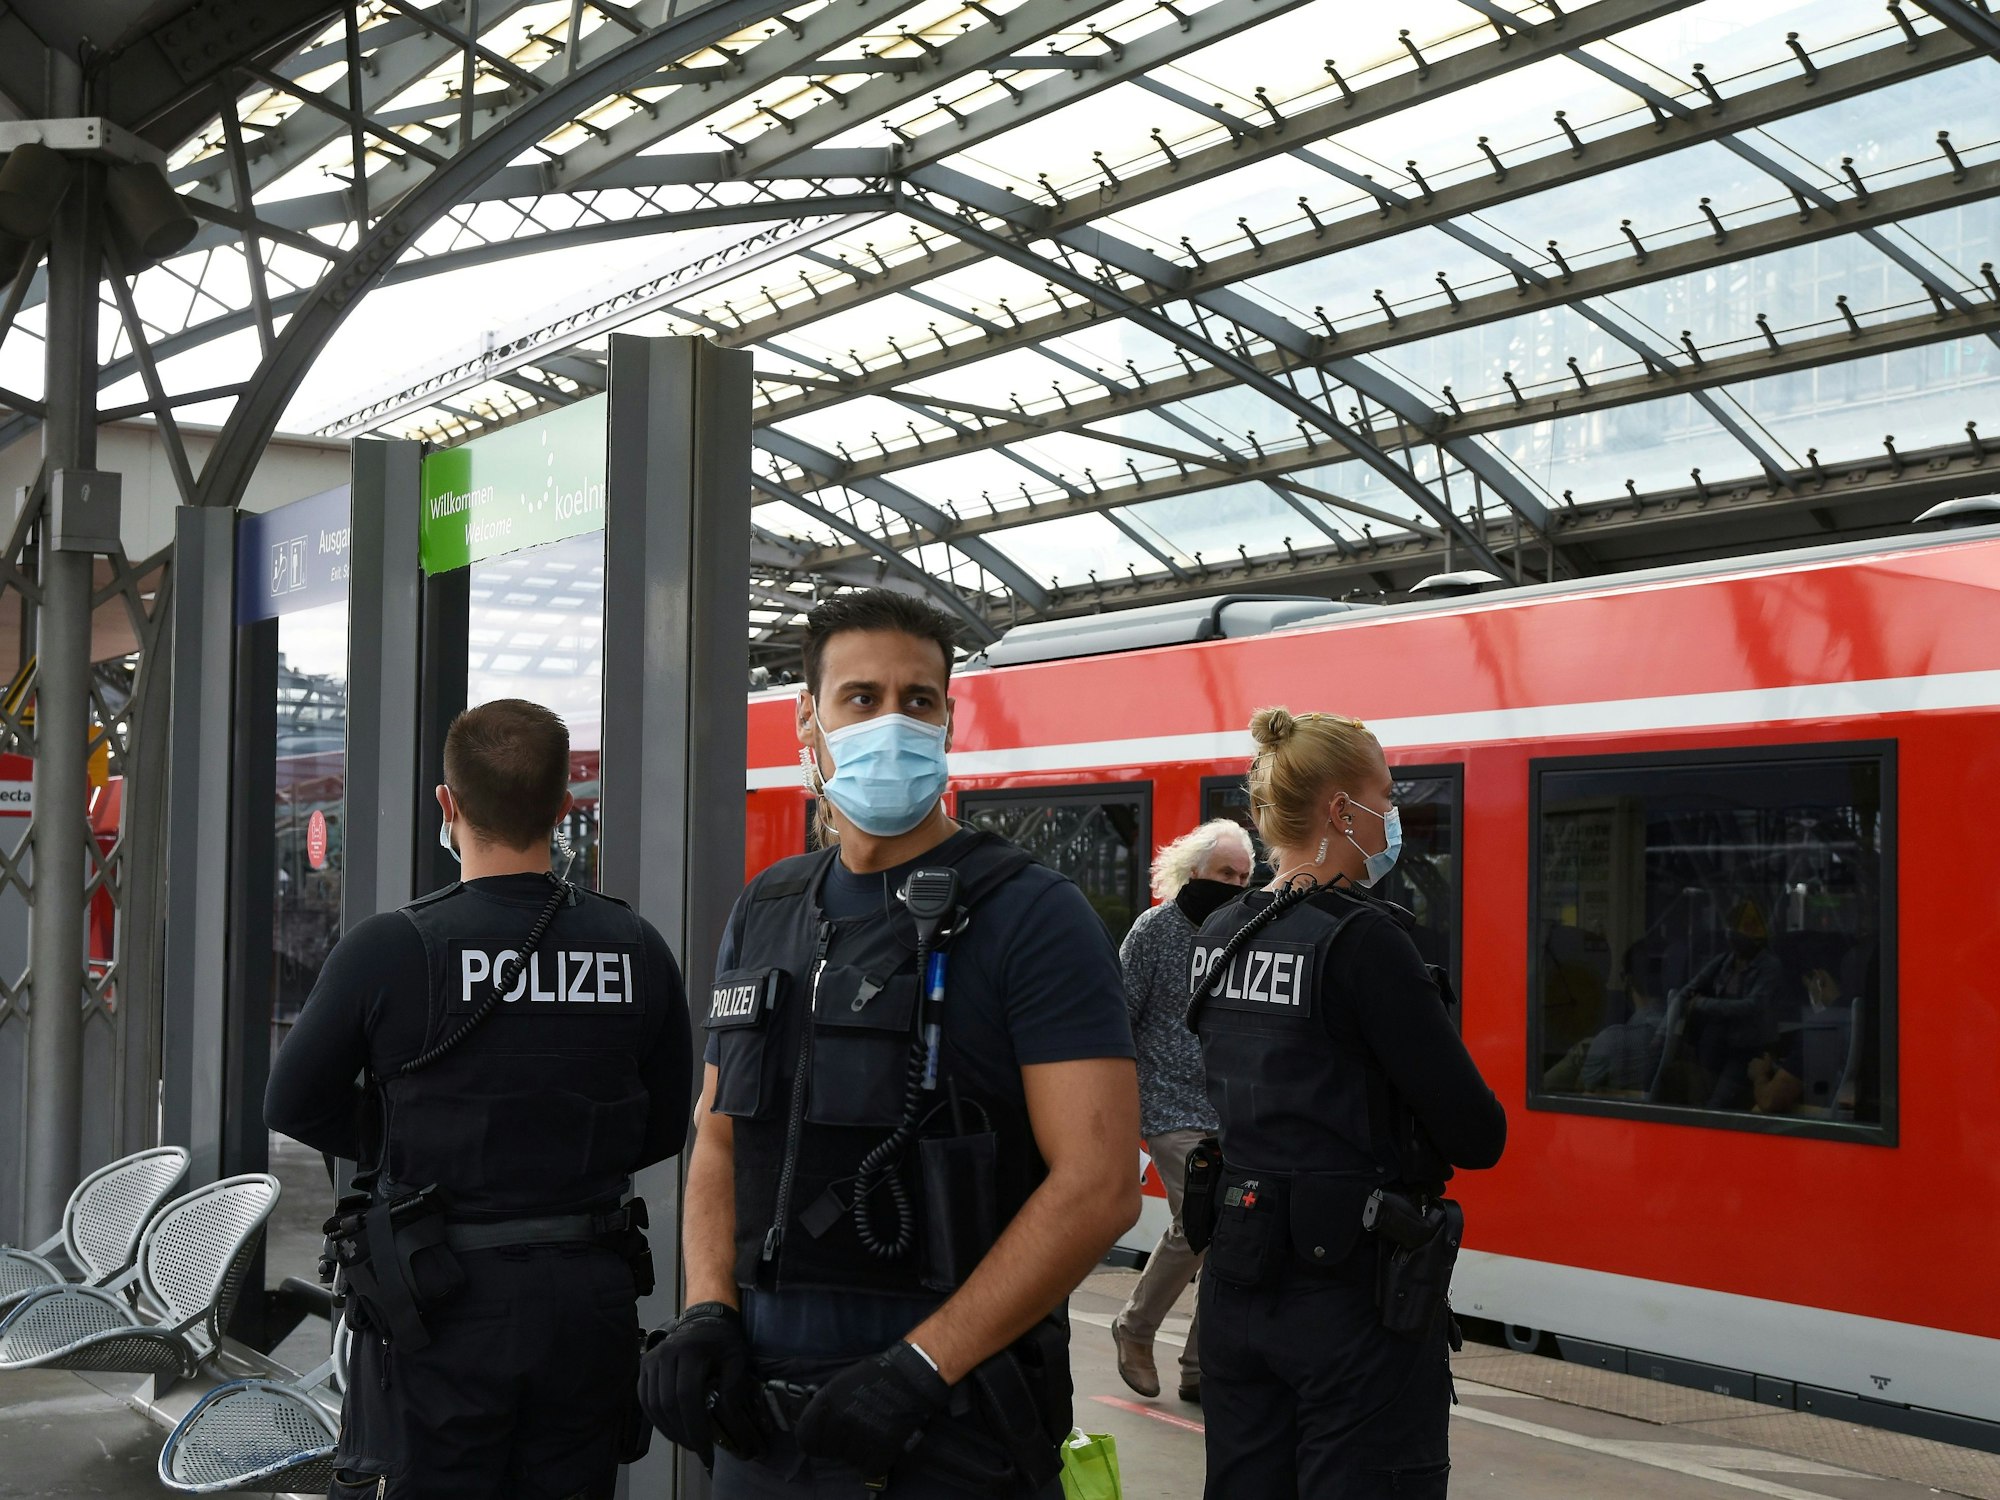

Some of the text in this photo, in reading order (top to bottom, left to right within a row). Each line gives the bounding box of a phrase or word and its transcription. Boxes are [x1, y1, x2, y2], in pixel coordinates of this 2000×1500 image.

[430, 485, 494, 519] Willkommen
[465, 517, 512, 546] Welcome
[461, 949, 633, 1003] POLIZEI
[1190, 946, 1304, 1006] POLIZEI
[710, 985, 756, 1019] POLIZEI
